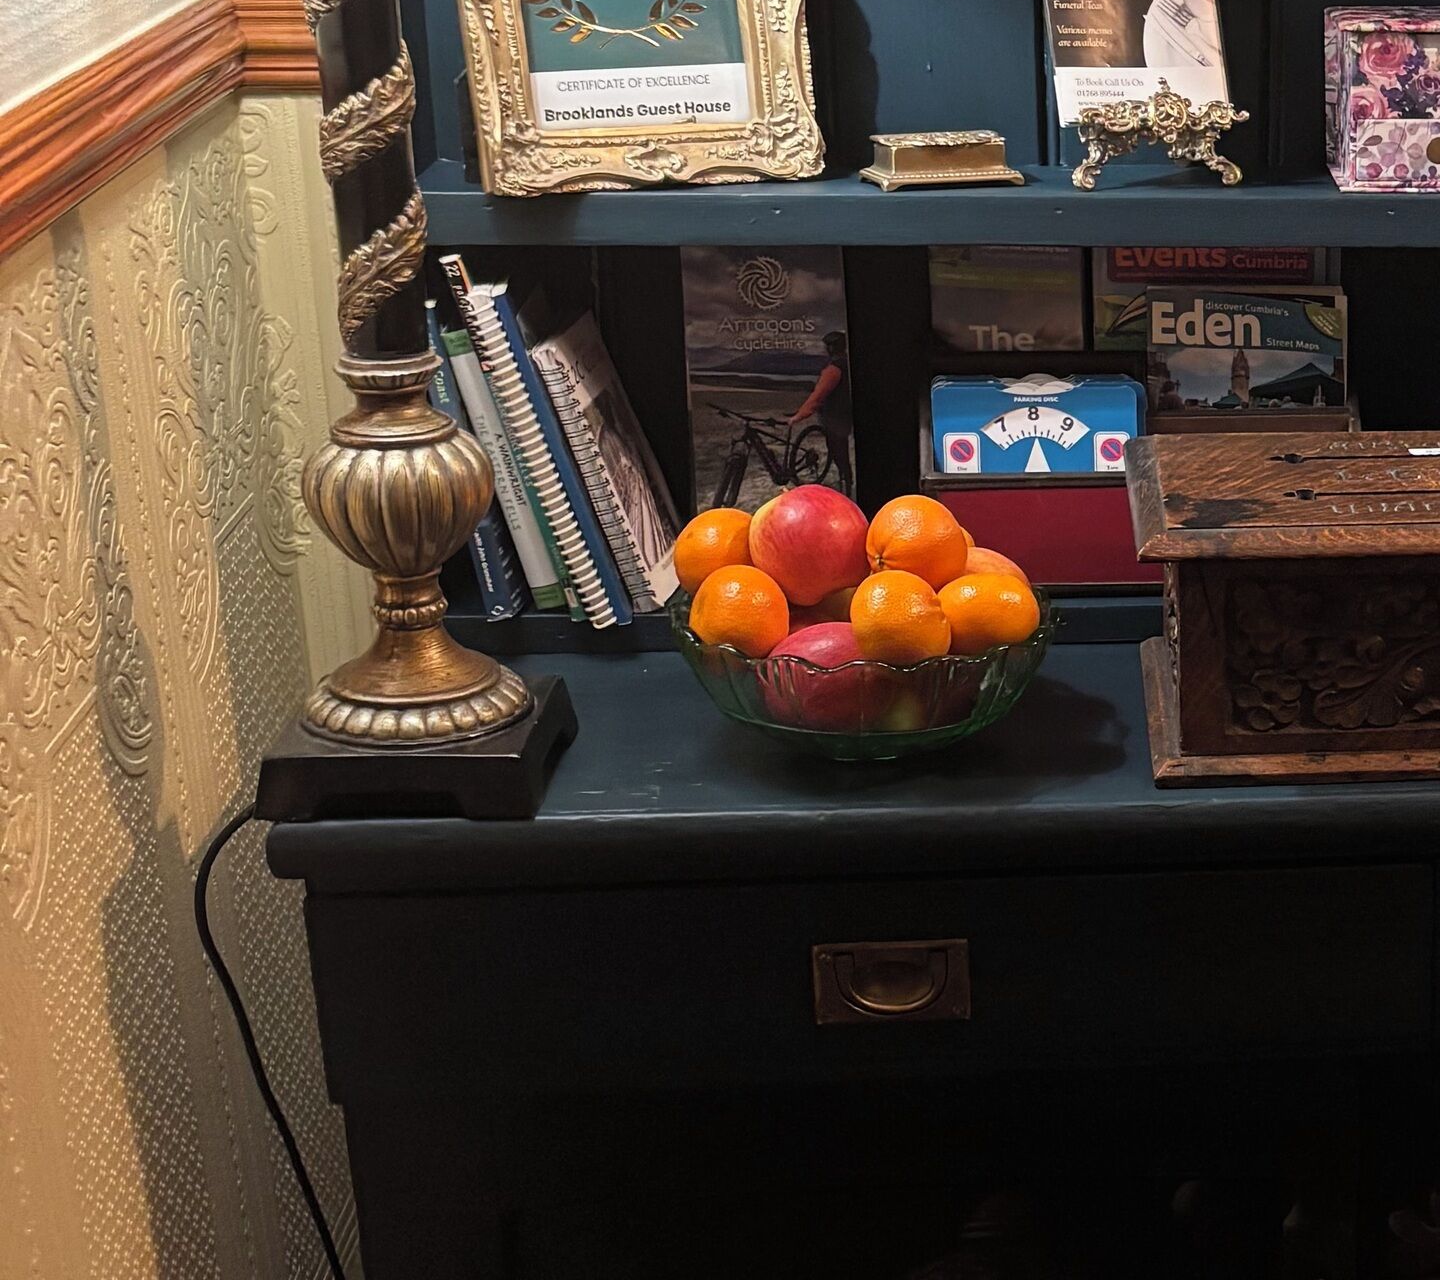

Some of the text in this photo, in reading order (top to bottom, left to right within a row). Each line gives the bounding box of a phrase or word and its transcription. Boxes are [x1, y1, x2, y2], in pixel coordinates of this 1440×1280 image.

[1053, 0, 1085, 10] Funeral
[1056, 24, 1087, 36] Various
[1058, 37, 1108, 48] are available
[557, 73, 711, 93] CERTIFICATE OF EXCELLENCE
[1075, 77, 1145, 87] To Book Call Us On
[544, 99, 732, 122] Brooklands Guest House
[1115, 246, 1309, 270] Events Cumbria
[718, 315, 816, 335] Arragon's
[1152, 299, 1290, 348] Eden discover Cumbria's
[734, 337, 807, 352] Cycle Hire
[968, 325, 1036, 351] The
[1266, 337, 1321, 351] Street Maps
[1027, 406, 1040, 421] 8
[993, 417, 1007, 433] 7
[1060, 417, 1075, 432] 9
[476, 414, 522, 531] THE FELLS
[499, 443, 528, 507] WAINWRIGHT
